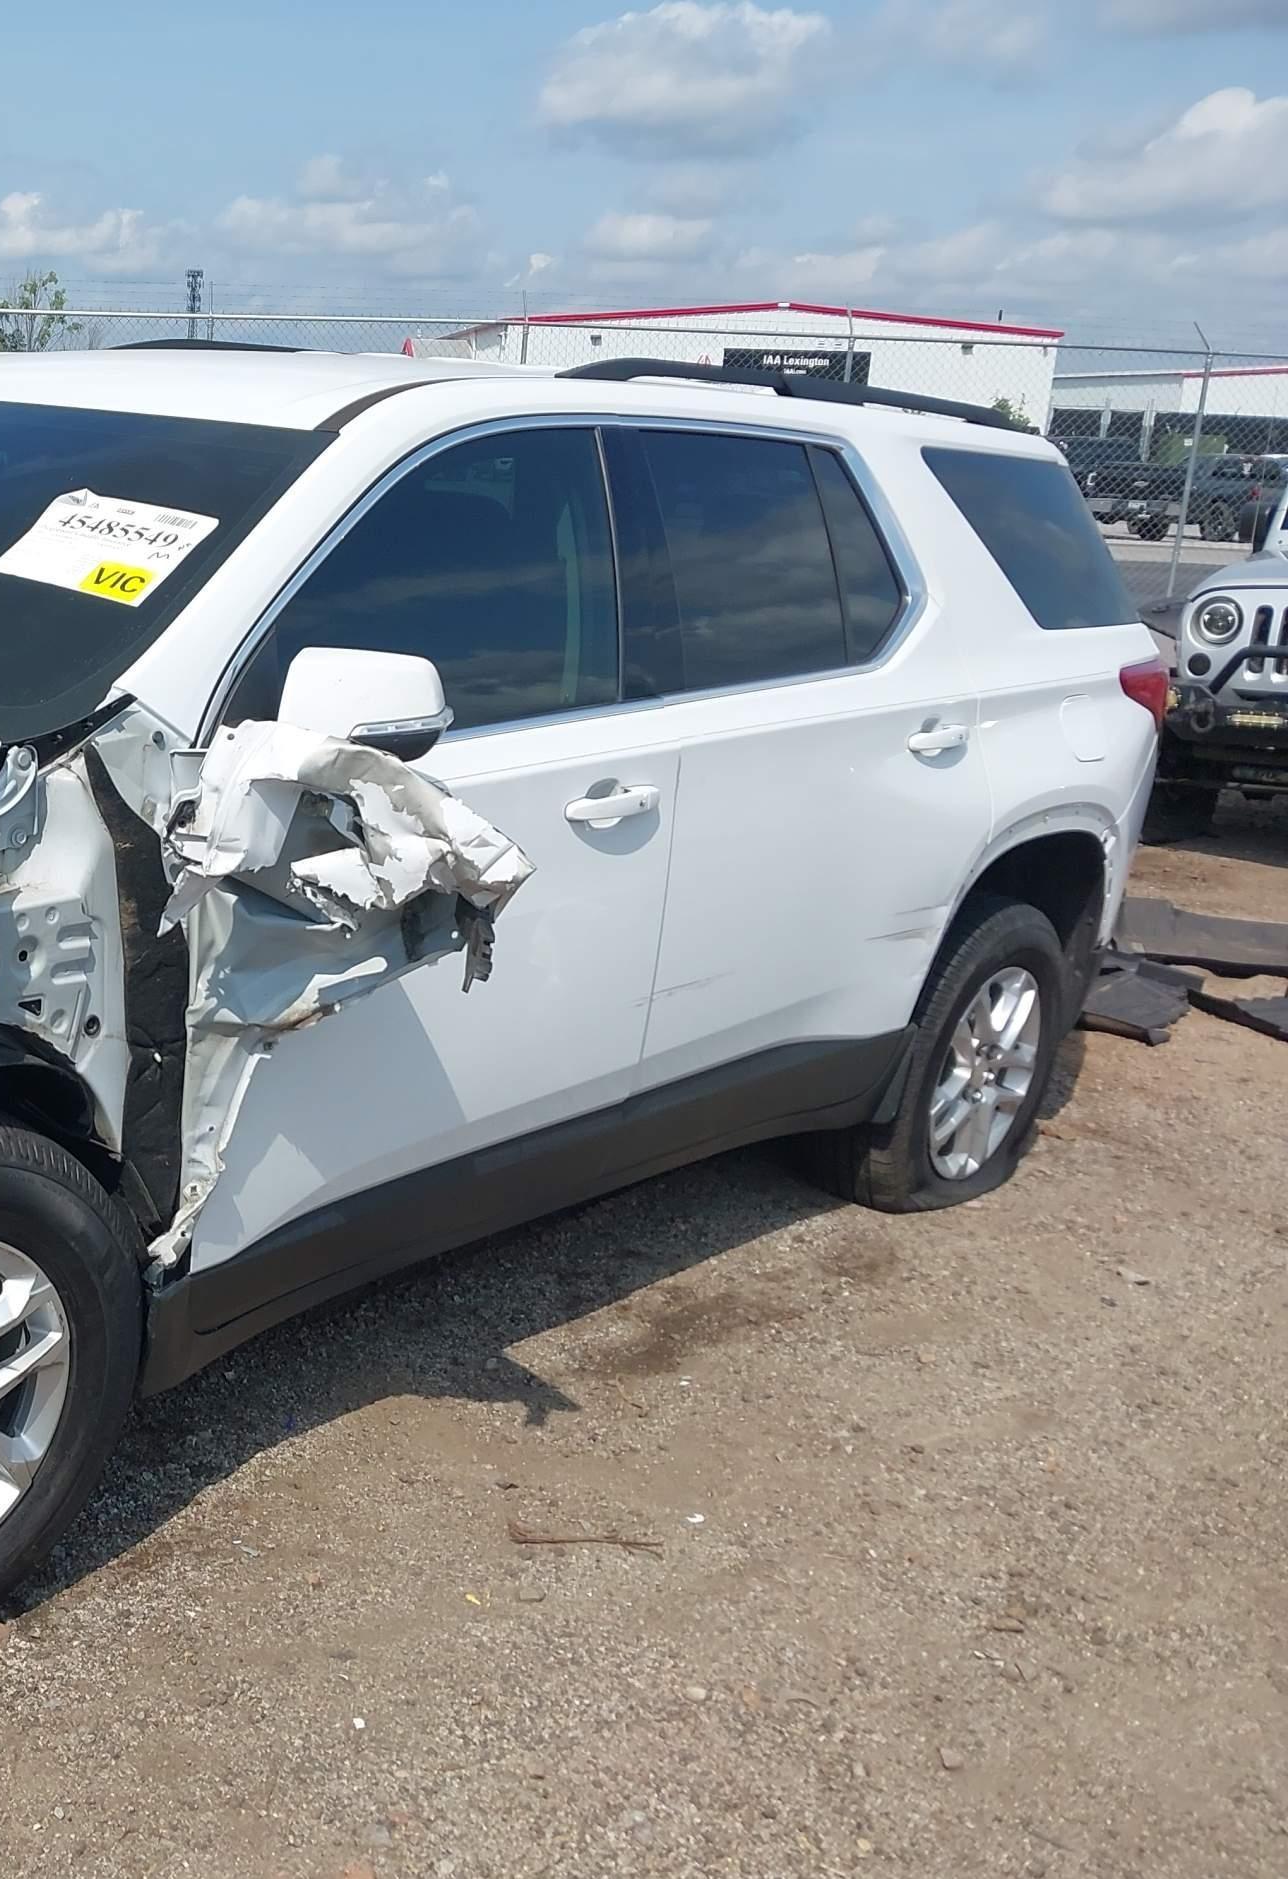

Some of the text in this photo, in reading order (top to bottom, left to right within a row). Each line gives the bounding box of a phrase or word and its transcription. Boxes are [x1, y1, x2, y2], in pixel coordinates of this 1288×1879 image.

[763, 354, 830, 368] IAA Lexington
[58, 512, 179, 548] 45485549
[93, 566, 146, 593] VIC
